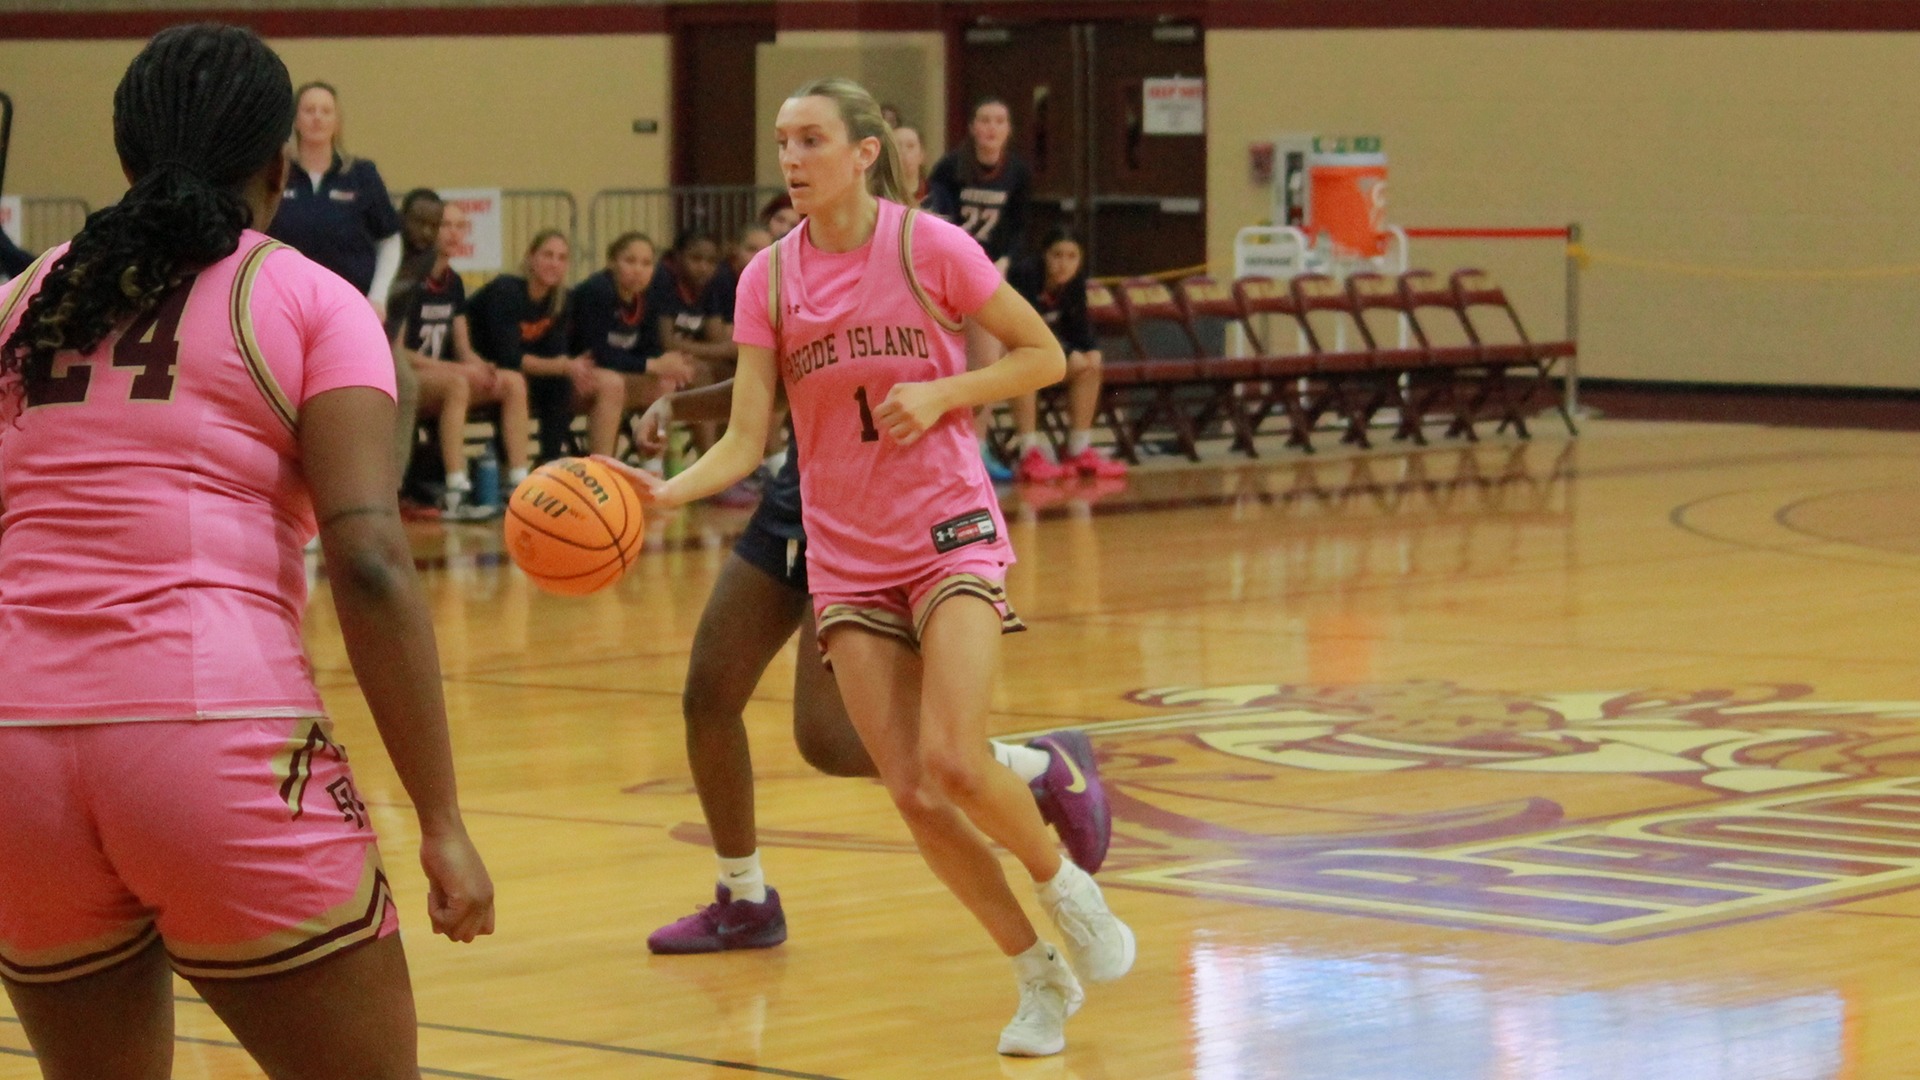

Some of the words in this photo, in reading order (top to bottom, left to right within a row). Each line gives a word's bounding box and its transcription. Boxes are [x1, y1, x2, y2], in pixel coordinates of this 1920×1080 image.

[846, 326, 930, 359] ISLAND
[854, 385, 880, 443] 1
[562, 461, 609, 505] son
